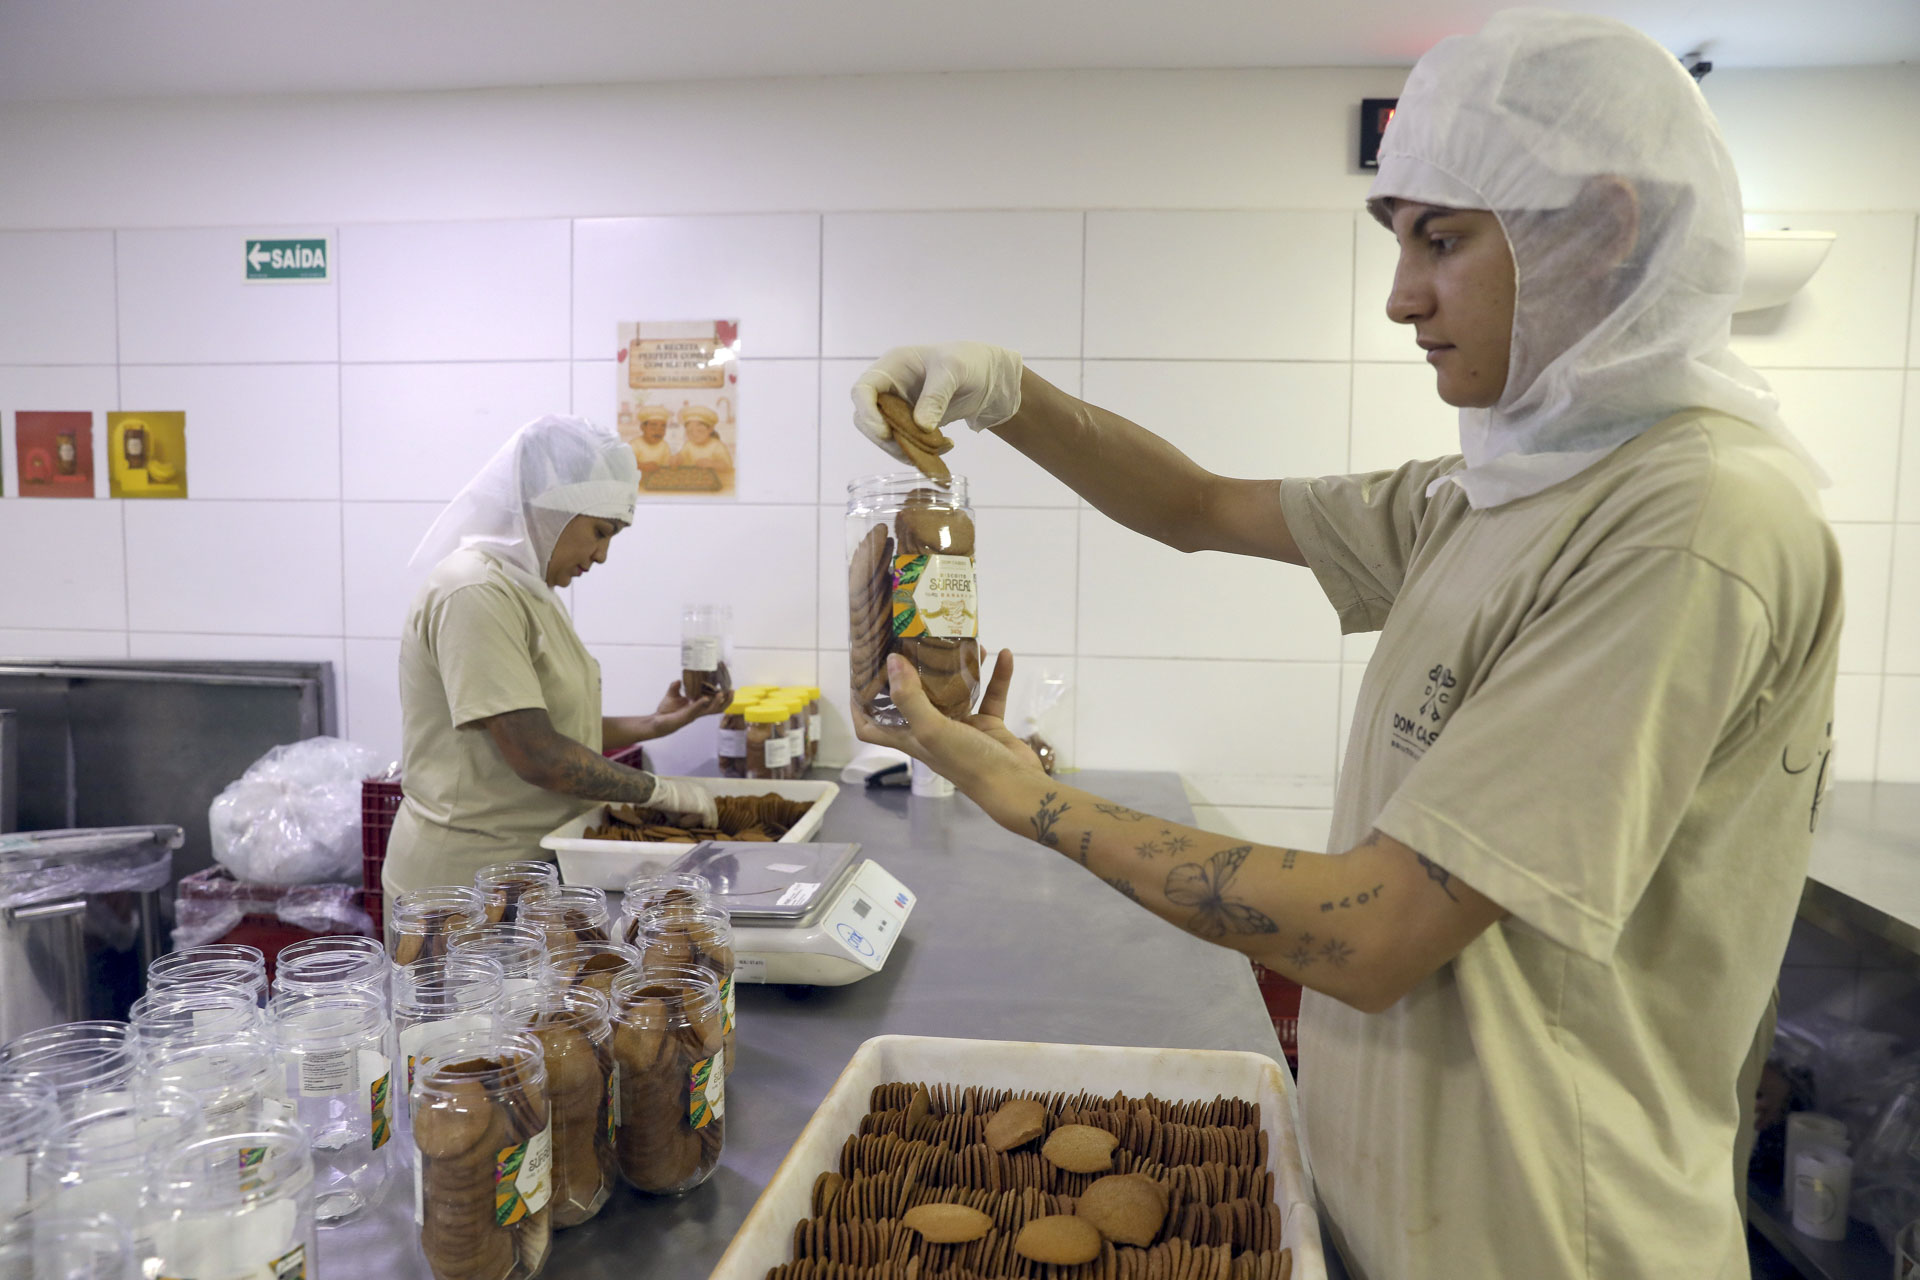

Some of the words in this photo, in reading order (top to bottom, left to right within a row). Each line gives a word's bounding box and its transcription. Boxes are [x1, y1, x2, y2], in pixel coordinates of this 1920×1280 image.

[271, 244, 325, 270] SAÍDA
[639, 352, 678, 360] PERFEITA
[1393, 713, 1415, 736] DOM
[1416, 726, 1439, 746] CAS
